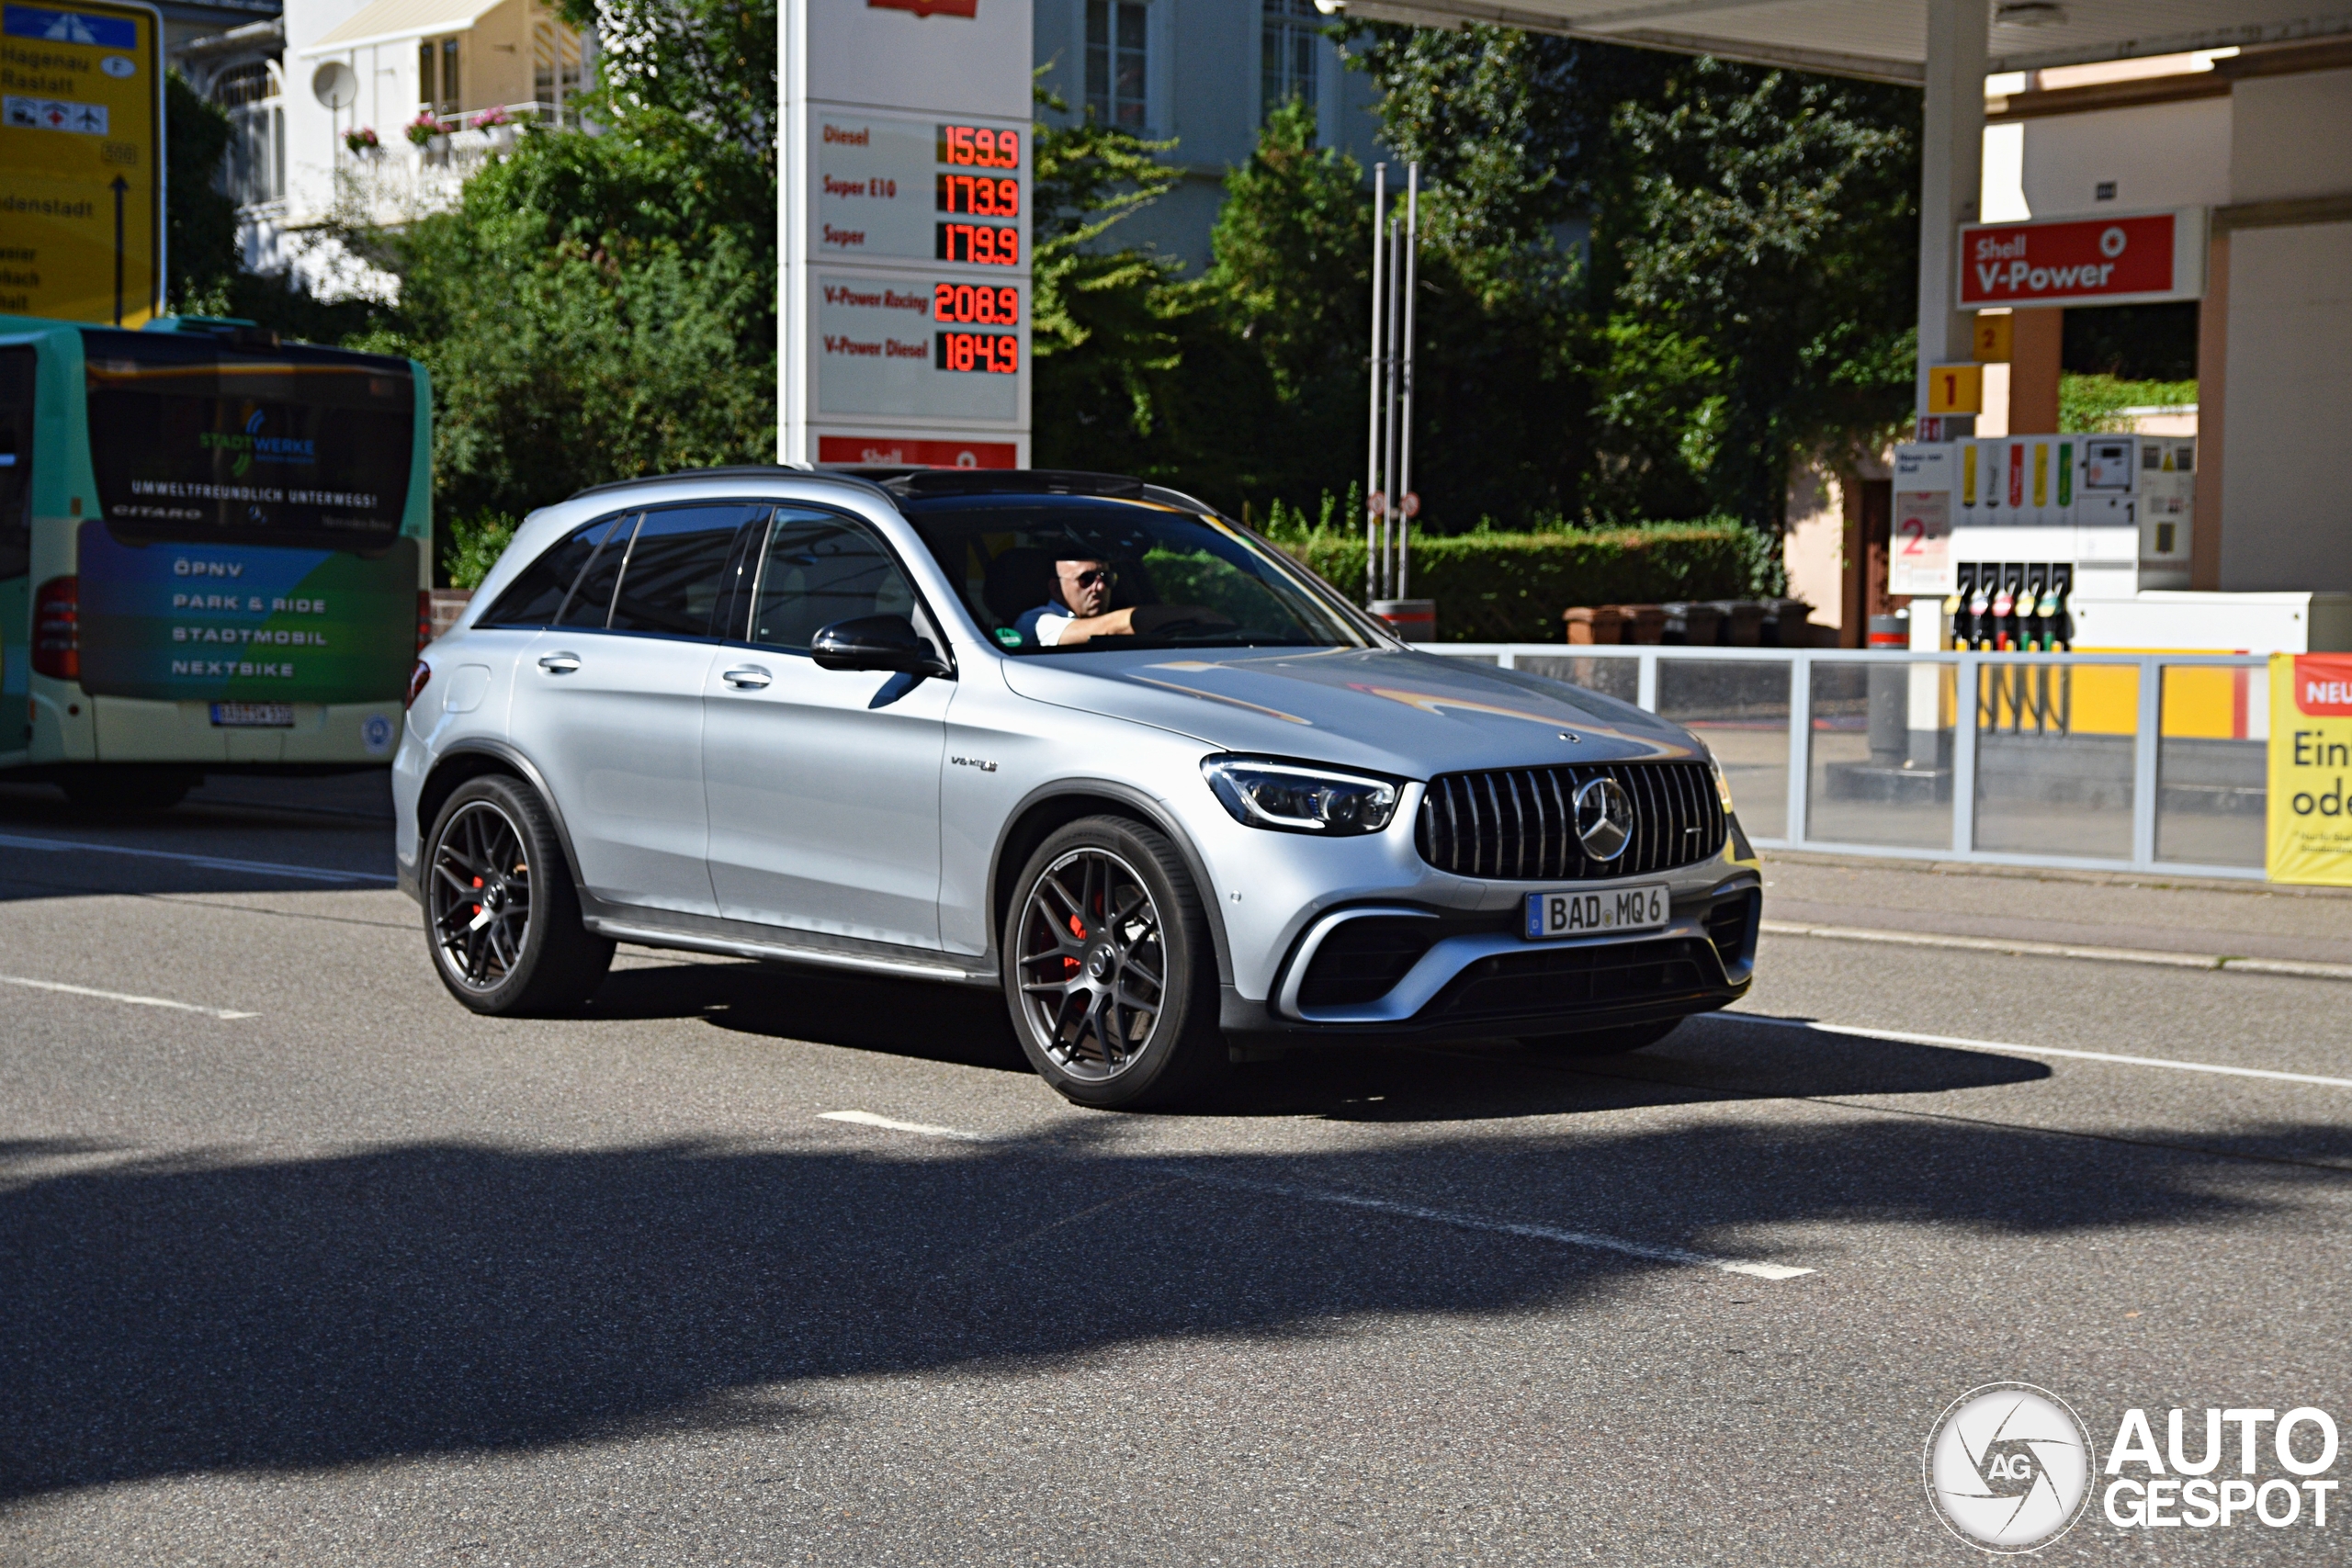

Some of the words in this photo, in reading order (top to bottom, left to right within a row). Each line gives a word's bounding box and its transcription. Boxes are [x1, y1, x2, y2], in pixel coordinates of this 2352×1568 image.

[823, 124, 869, 146] Diesel
[945, 126, 1019, 169] 159.9
[823, 174, 865, 198] Super
[869, 177, 897, 198] E10
[945, 175, 1019, 217] 173.9
[823, 223, 865, 248] Super
[945, 223, 1019, 265] 179.9
[1975, 234, 2027, 260] Shell
[1975, 260, 2115, 294] V-Power
[823, 286, 881, 309] V-Power
[884, 289, 929, 315] Racing
[934, 283, 1019, 325] 208.9
[823, 334, 881, 356] V-Power
[886, 338, 928, 358] Diesel
[945, 332, 1019, 373] 184.9
[1982, 329, 1996, 348] 2
[1944, 373, 1955, 406] 1
[198, 432, 315, 456] STADTWERKE
[131, 479, 284, 502] UMWELTFREUNDLICH
[288, 489, 378, 509] UNTERWEGS!
[111, 503, 203, 520] CITARO
[2126, 501, 2134, 524] 1
[1902, 517, 1925, 555] 2
[174, 556, 243, 577] ÖPNV
[173, 593, 239, 611] PARK
[248, 595, 264, 612] &
[272, 597, 325, 614] RIDE
[172, 626, 327, 646] STADTMOBIL
[171, 660, 294, 678] NEXTBIKE
[1551, 896, 1600, 931] BAD
[1616, 892, 1645, 926] MQ
[1649, 890, 1660, 922] 6
